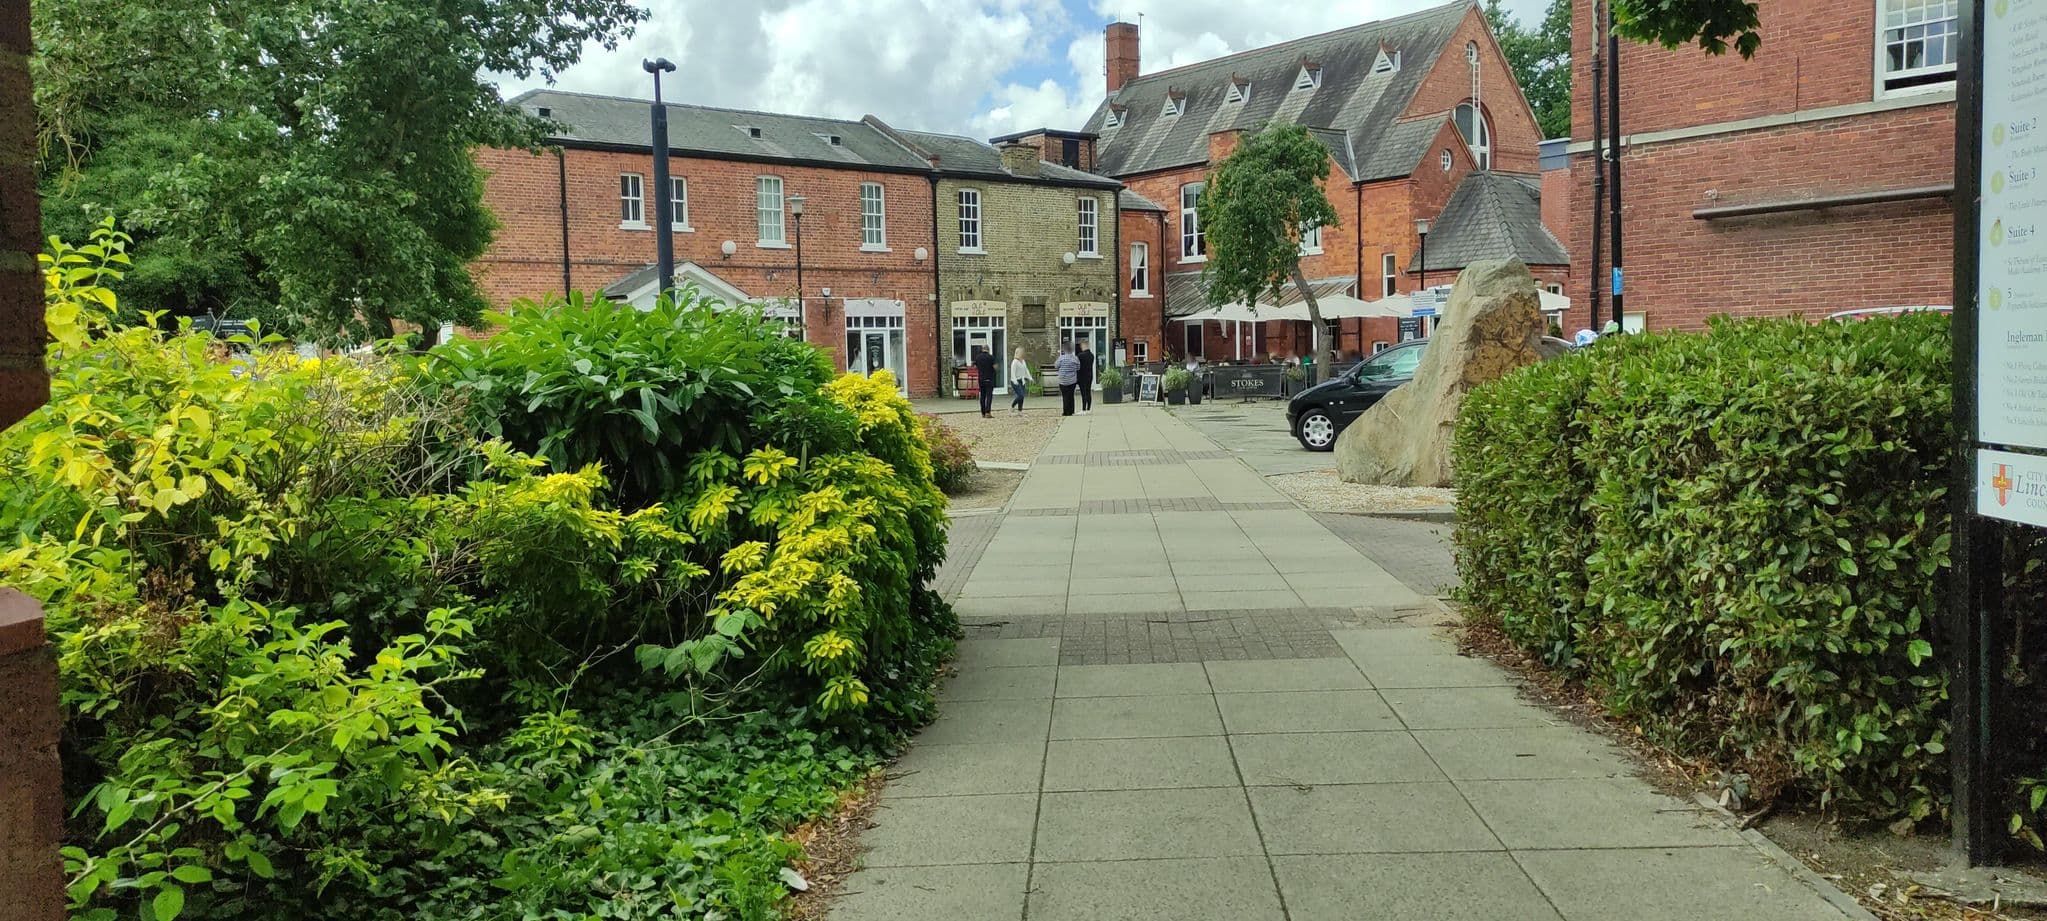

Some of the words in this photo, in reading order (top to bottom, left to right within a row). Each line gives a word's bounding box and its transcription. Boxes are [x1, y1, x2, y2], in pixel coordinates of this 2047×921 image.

[2010, 120, 2030, 134] Suite
[2031, 117, 2037, 129] 2
[2009, 169, 2029, 183] Suite
[2030, 167, 2036, 179] 3
[2008, 224, 2028, 238] Suite
[2029, 224, 2035, 236] 4
[2007, 287, 2012, 299] 5
[2007, 329, 2043, 343] Ingleman
[1231, 379, 1264, 387] STOKES
[2027, 471, 2043, 482] CITY
